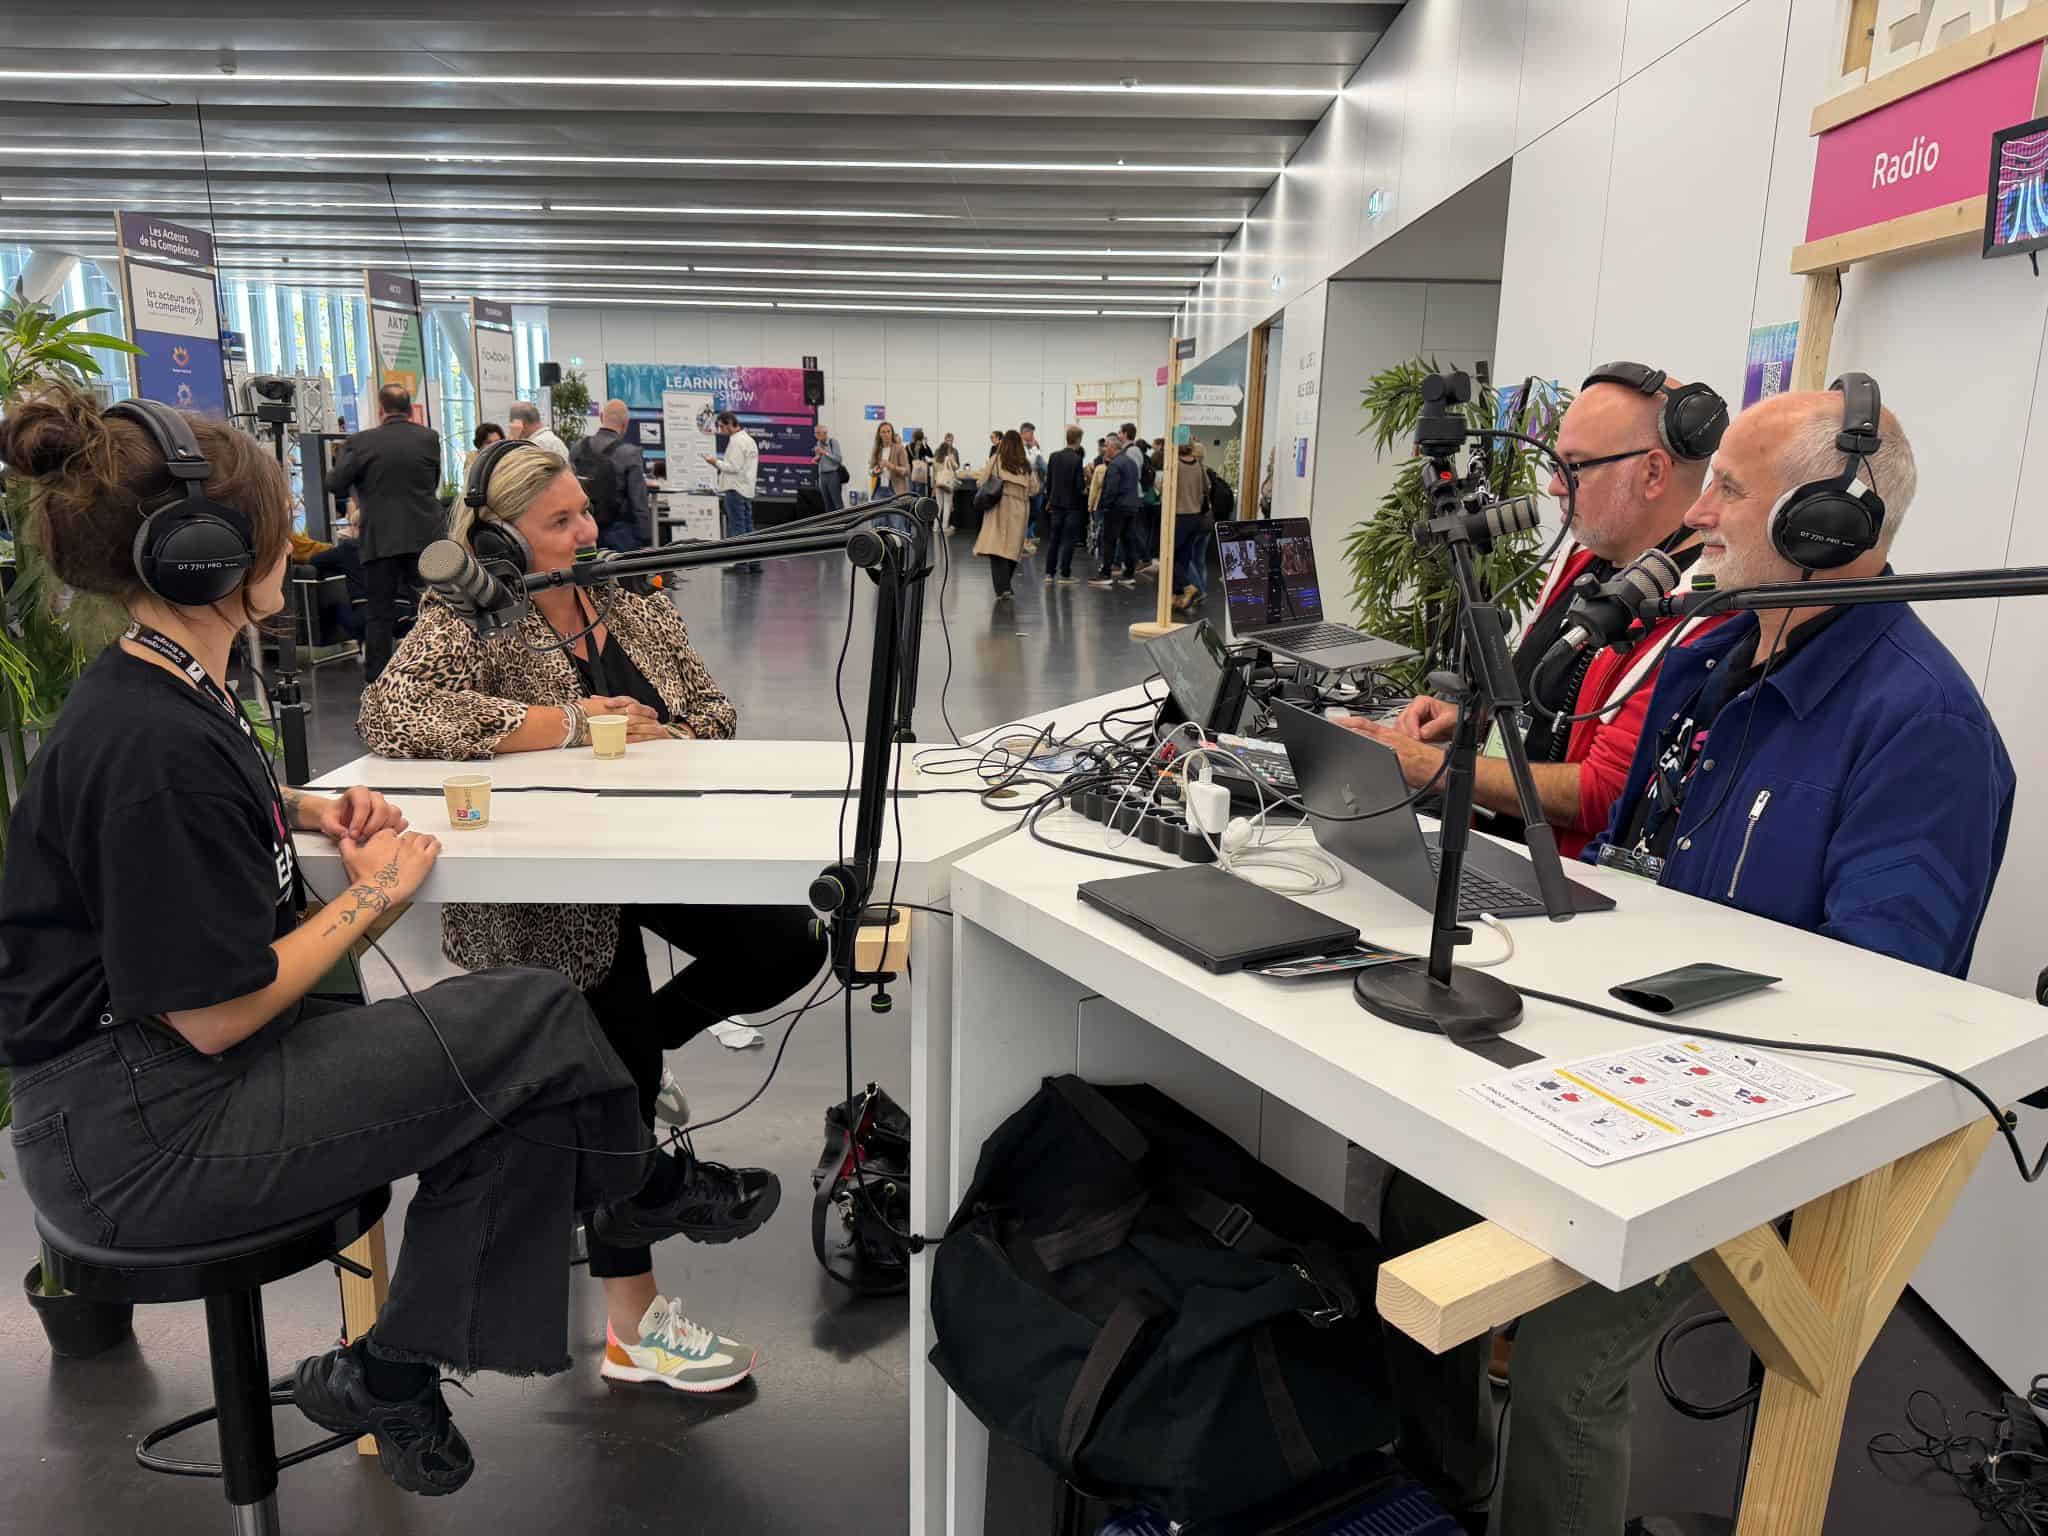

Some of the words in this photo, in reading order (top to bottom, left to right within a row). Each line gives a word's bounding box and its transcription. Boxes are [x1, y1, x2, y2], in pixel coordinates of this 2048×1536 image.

[1872, 136, 1939, 190] Radio
[149, 225, 161, 237] Les
[162, 229, 189, 243] Acteurs
[140, 234, 149, 247] de
[150, 236, 157, 248] la
[158, 240, 200, 257] Compétence
[146, 288, 157, 297] les
[159, 292, 185, 303] acteurs
[147, 299, 154, 308] la
[154, 302, 196, 315] compétence
[666, 375, 739, 391] LEARNING
[720, 391, 754, 402] SHOW
